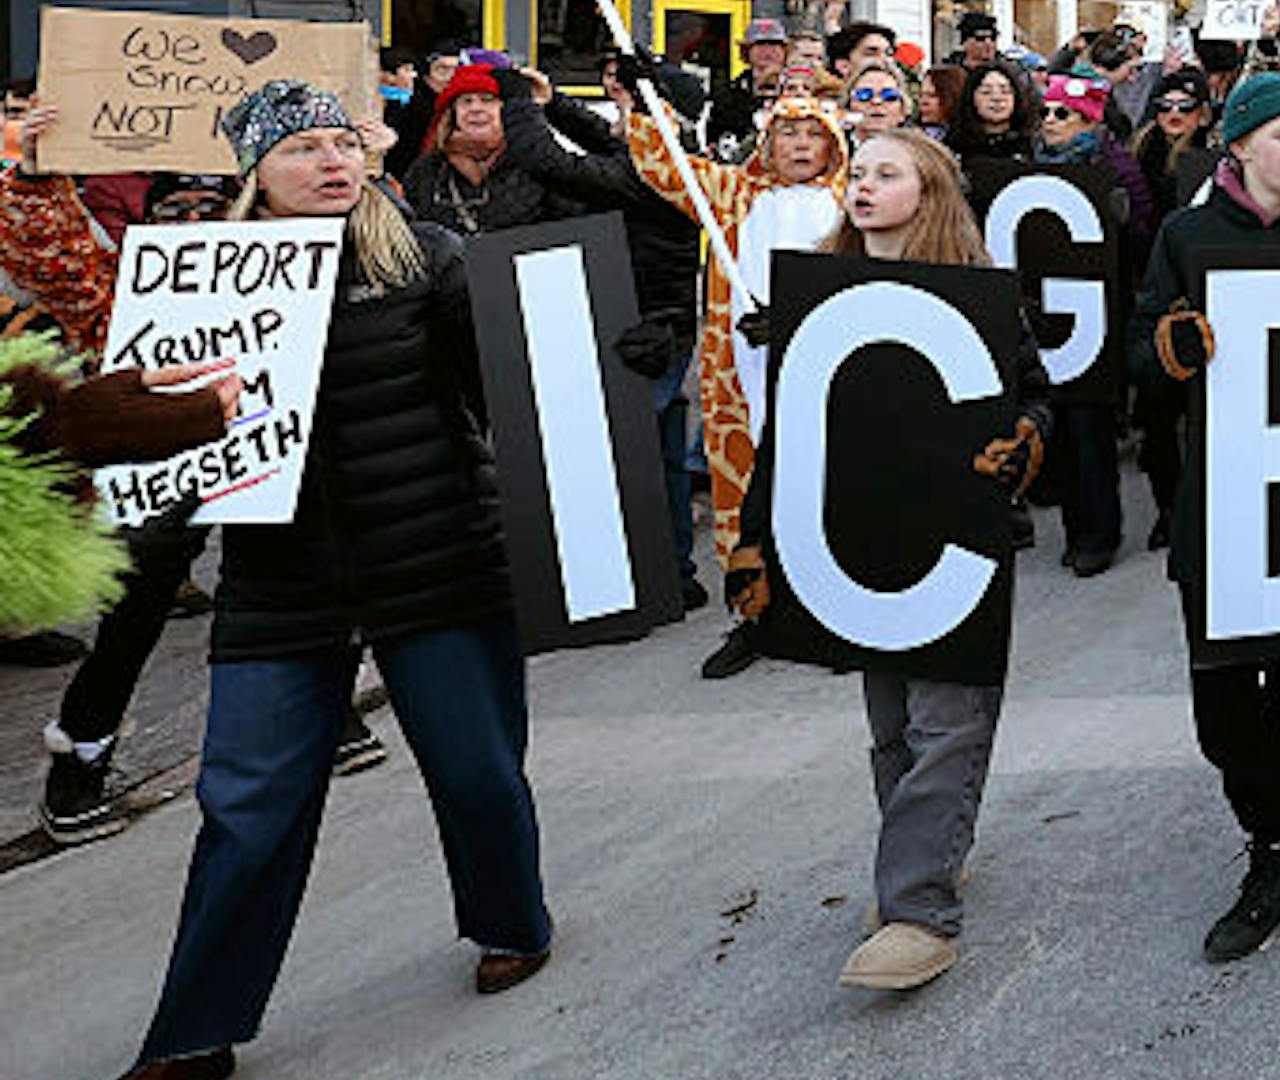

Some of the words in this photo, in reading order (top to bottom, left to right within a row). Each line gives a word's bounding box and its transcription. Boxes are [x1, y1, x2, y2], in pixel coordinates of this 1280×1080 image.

[122, 26, 207, 66] We
[92, 101, 198, 137] NOT
[131, 240, 336, 296] DEPORT
[108, 410, 302, 518] HEGSETH
